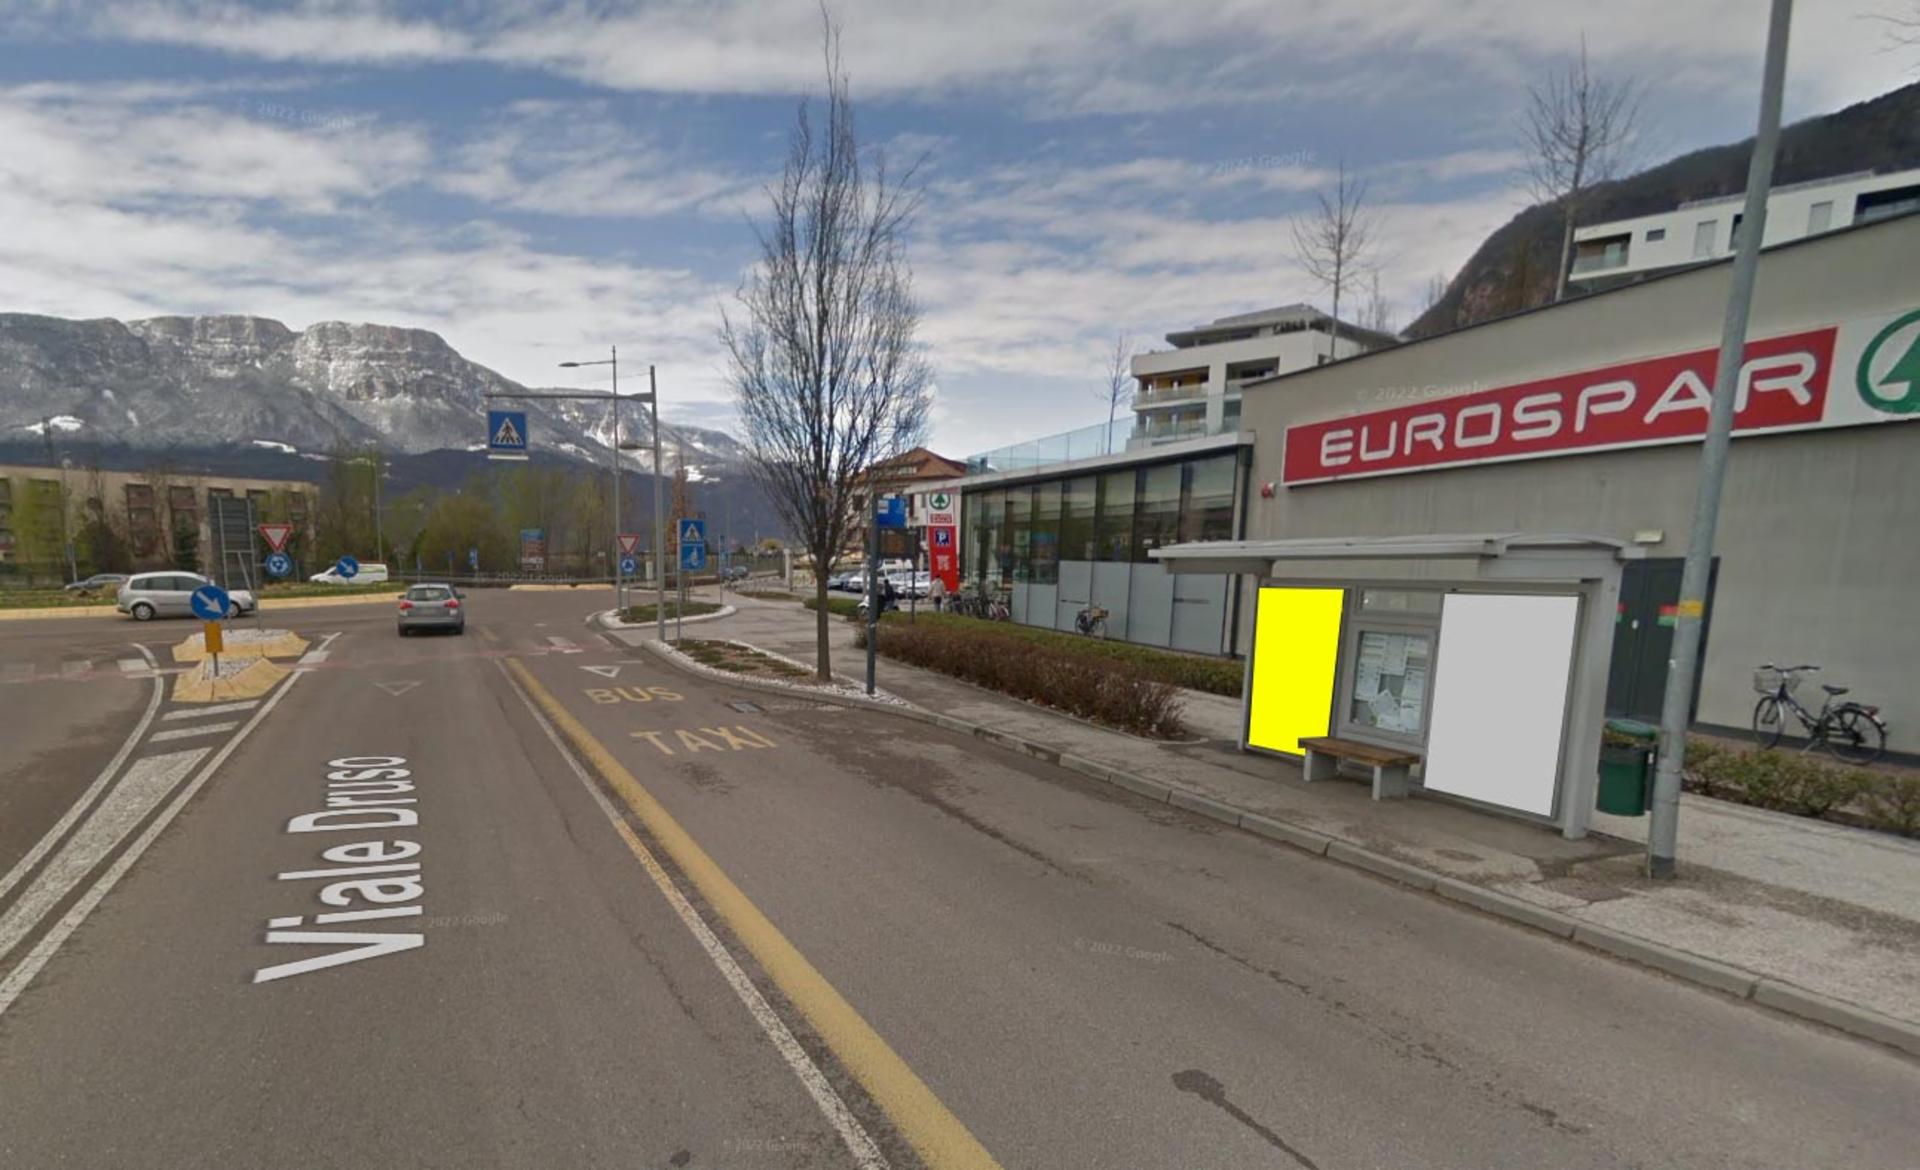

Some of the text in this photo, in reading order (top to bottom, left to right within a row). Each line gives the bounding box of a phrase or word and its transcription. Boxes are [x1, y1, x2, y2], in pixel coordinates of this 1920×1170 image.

[1319, 351, 1818, 468] EUROSPAR
[584, 686, 685, 705] BUS
[629, 725, 779, 755] TAXI
